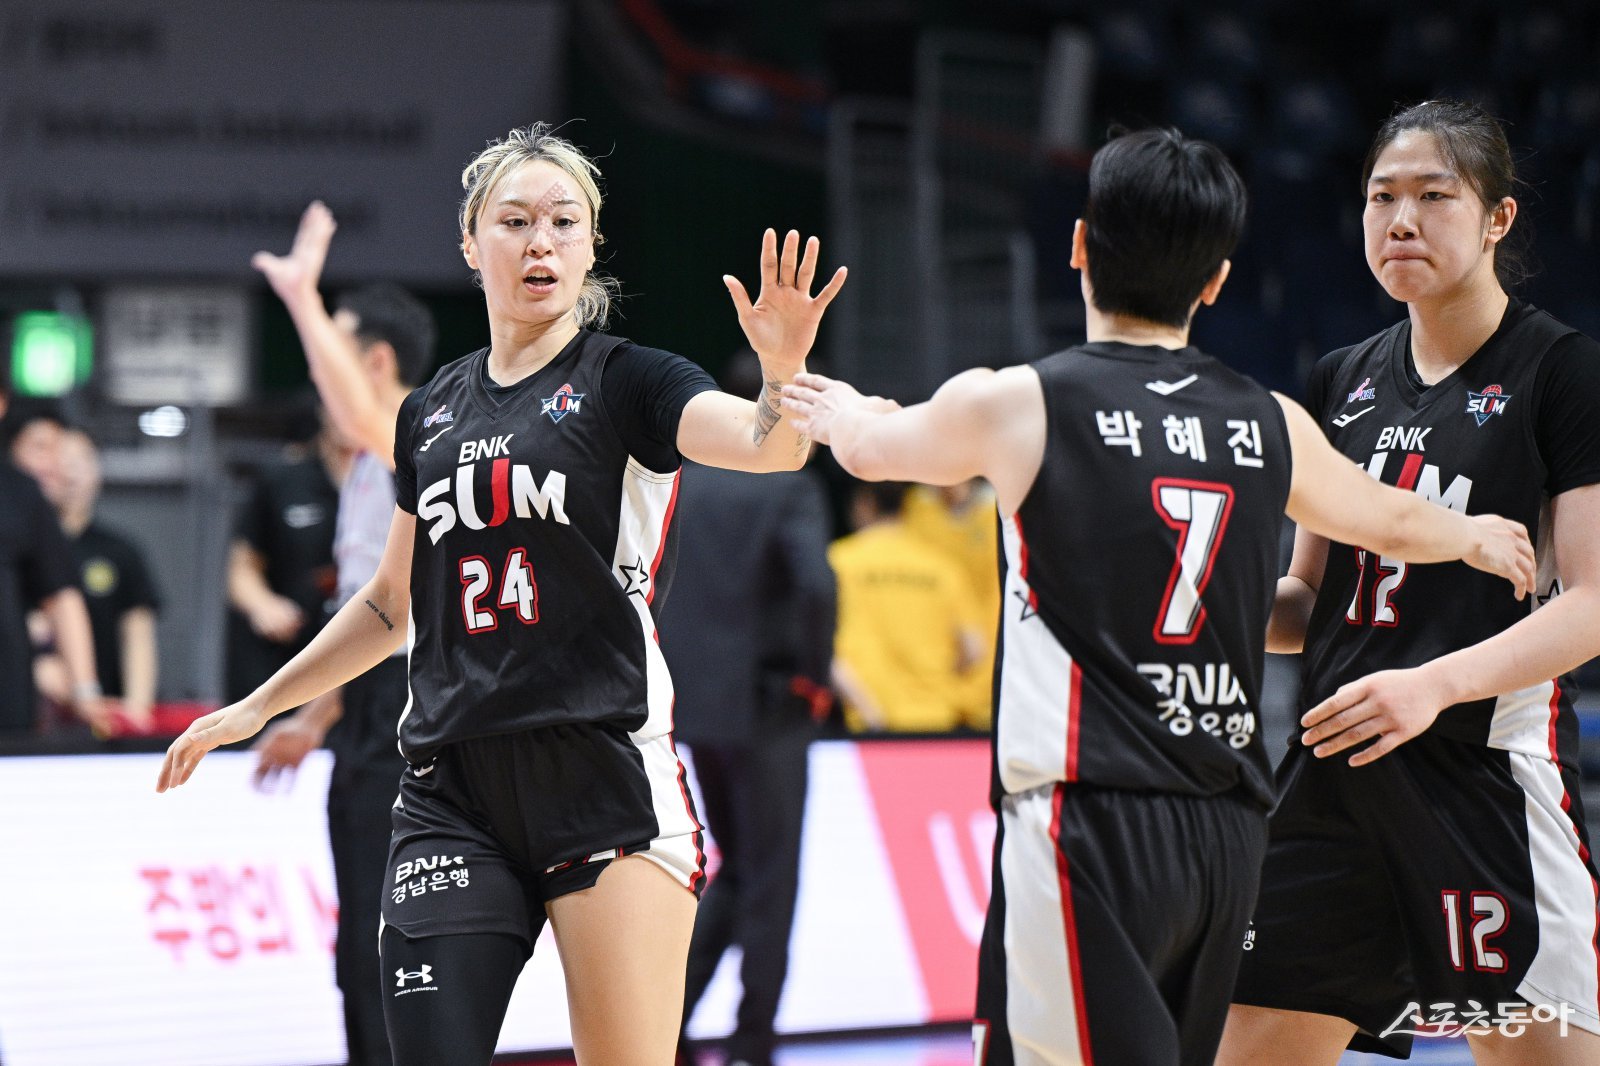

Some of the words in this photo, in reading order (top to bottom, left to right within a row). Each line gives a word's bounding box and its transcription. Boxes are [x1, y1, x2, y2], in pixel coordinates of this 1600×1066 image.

[540, 396, 581, 414] SUM
[1467, 397, 1506, 415] SUM
[458, 433, 515, 464] BNK
[1375, 426, 1433, 452] BNK
[417, 457, 571, 547] SUM
[1152, 476, 1235, 645] 7
[458, 547, 540, 635] 24
[365, 599, 379, 613] sure
[379, 611, 394, 631] thing
[391, 868, 470, 904] 경남은행
[1441, 889, 1511, 974] 12
